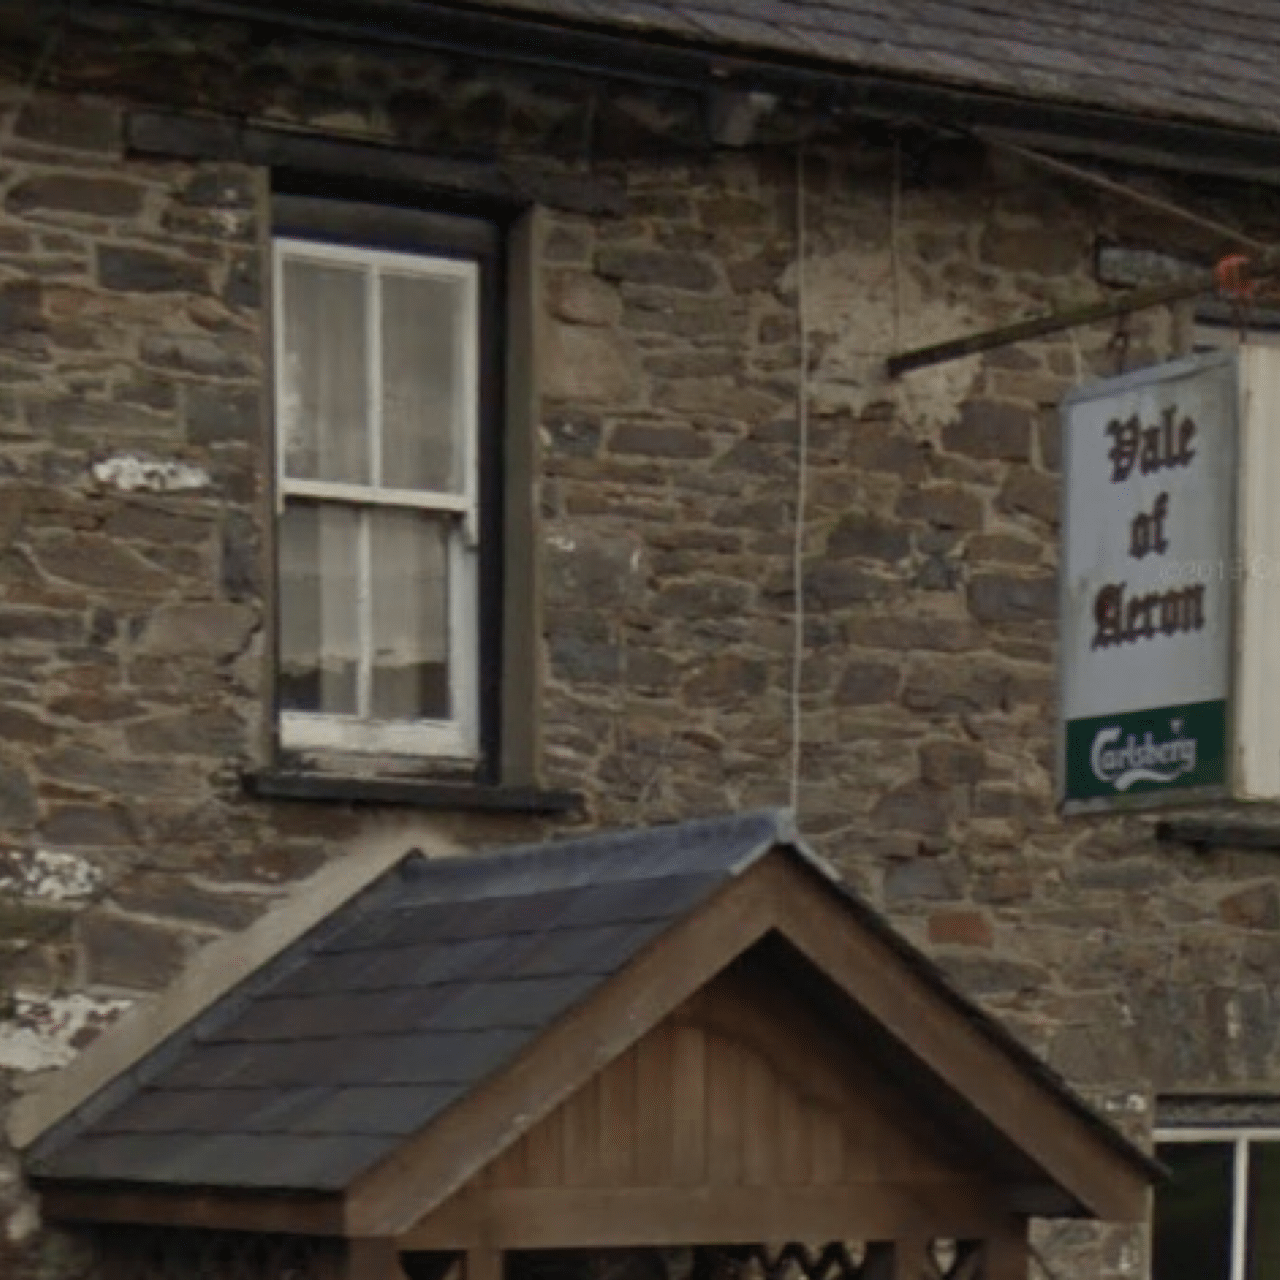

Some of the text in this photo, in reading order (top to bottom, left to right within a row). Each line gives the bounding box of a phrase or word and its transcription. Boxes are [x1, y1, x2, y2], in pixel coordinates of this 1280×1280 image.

[1105, 404, 1197, 484] Vale
[1128, 491, 1170, 559] of
[1091, 582, 1206, 651] Aeron
[1090, 718, 1197, 791] Carlsberg
